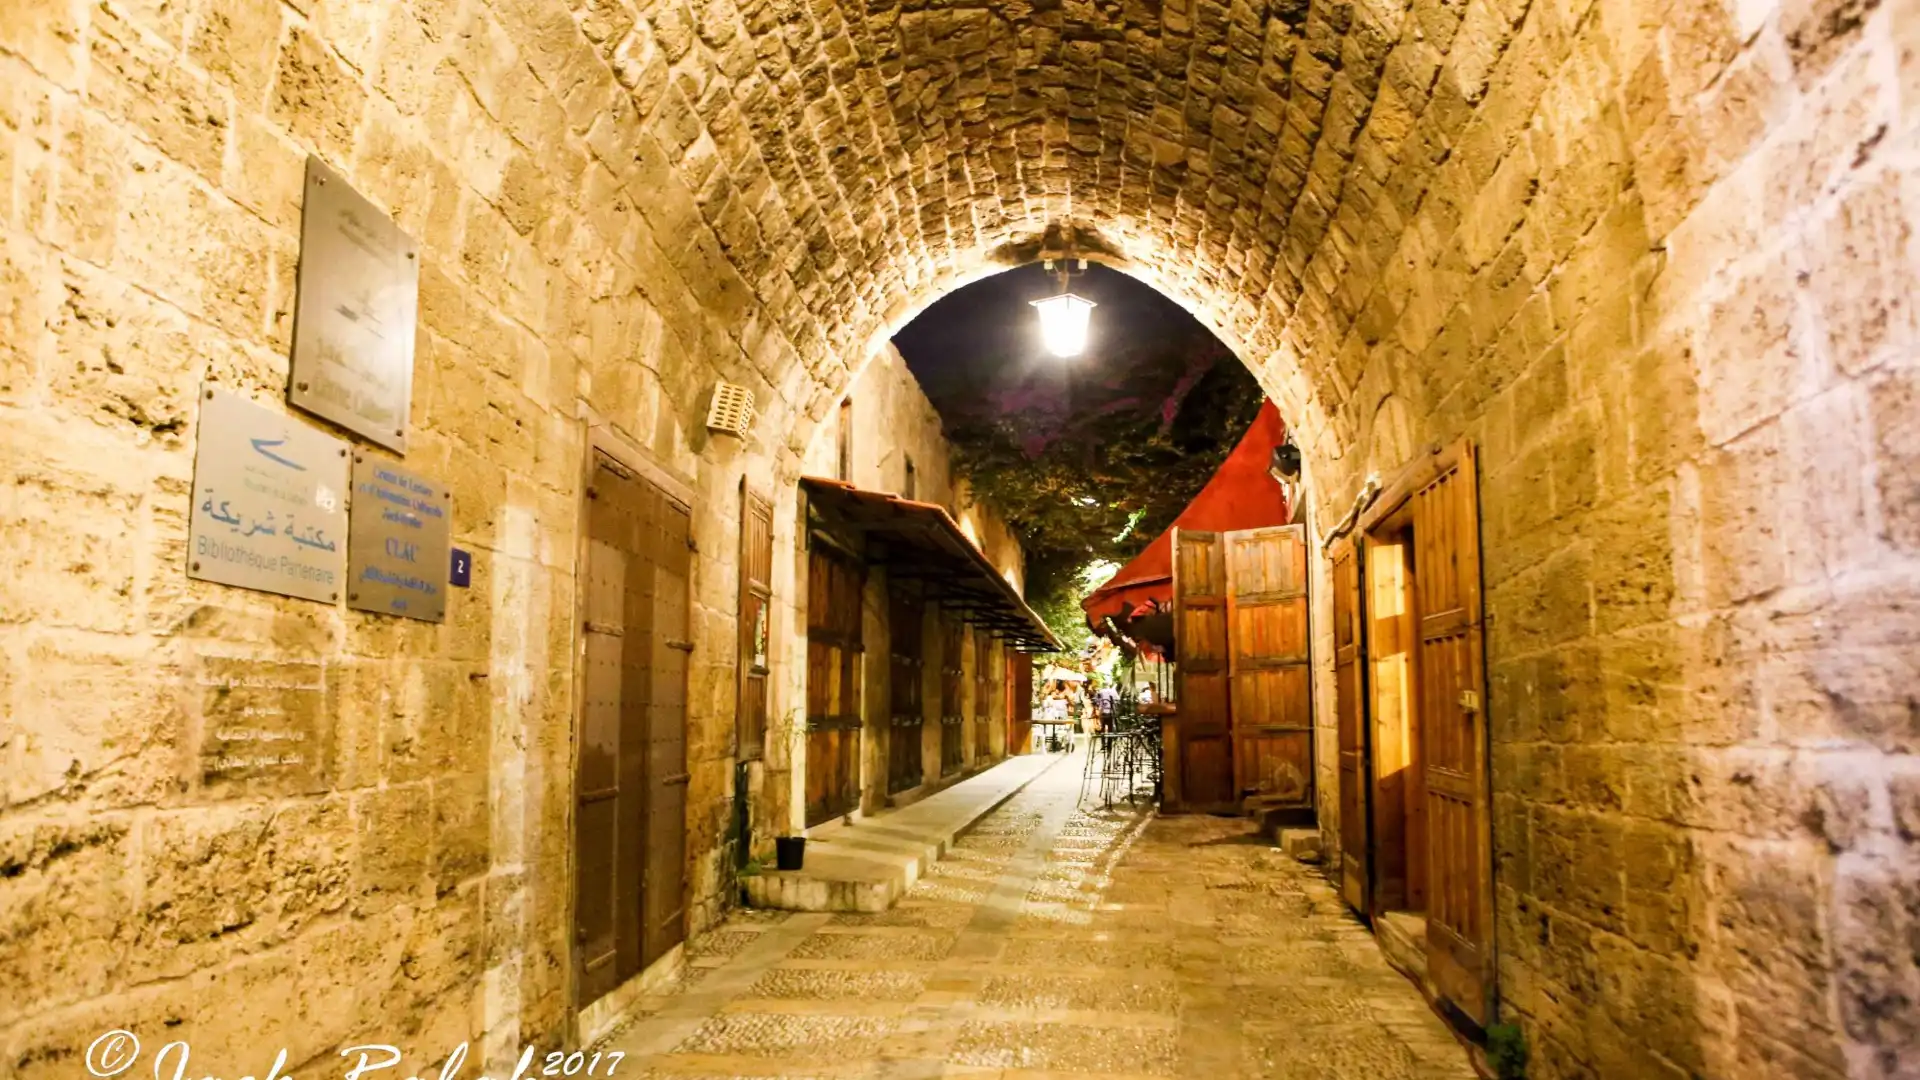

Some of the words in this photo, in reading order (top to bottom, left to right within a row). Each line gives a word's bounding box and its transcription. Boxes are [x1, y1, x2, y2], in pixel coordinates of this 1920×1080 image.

[201, 488, 276, 537] شريكة
[284, 514, 335, 552] مكتبة
[281, 555, 335, 585] Partenaire
[457, 559, 465, 574] 2
